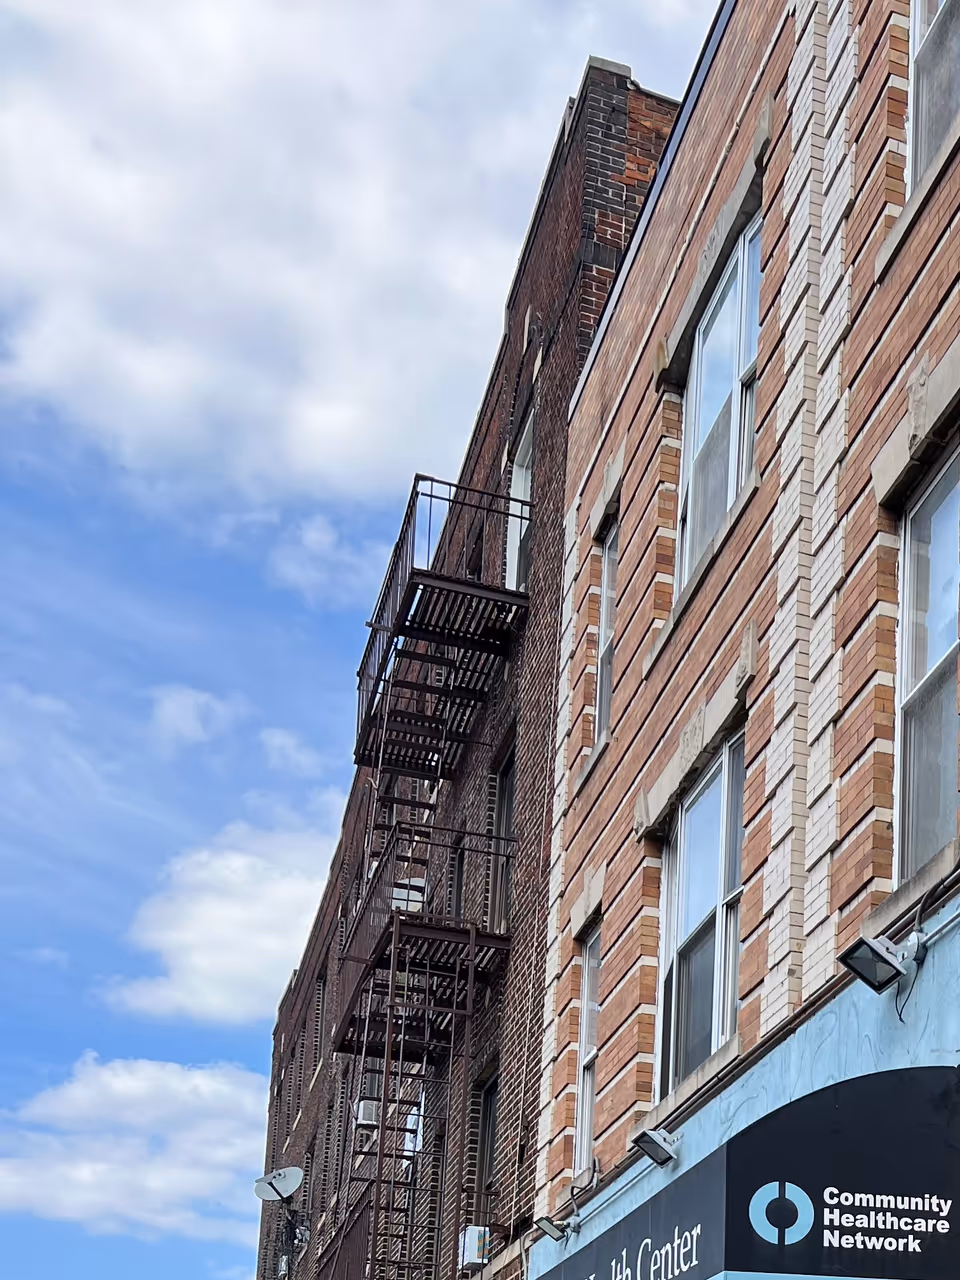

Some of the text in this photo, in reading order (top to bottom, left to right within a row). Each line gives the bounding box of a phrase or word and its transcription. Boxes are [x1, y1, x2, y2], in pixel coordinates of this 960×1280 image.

[824, 1187, 952, 1216] Community
[824, 1209, 950, 1233] Healthcare
[824, 1230, 921, 1252] Network
